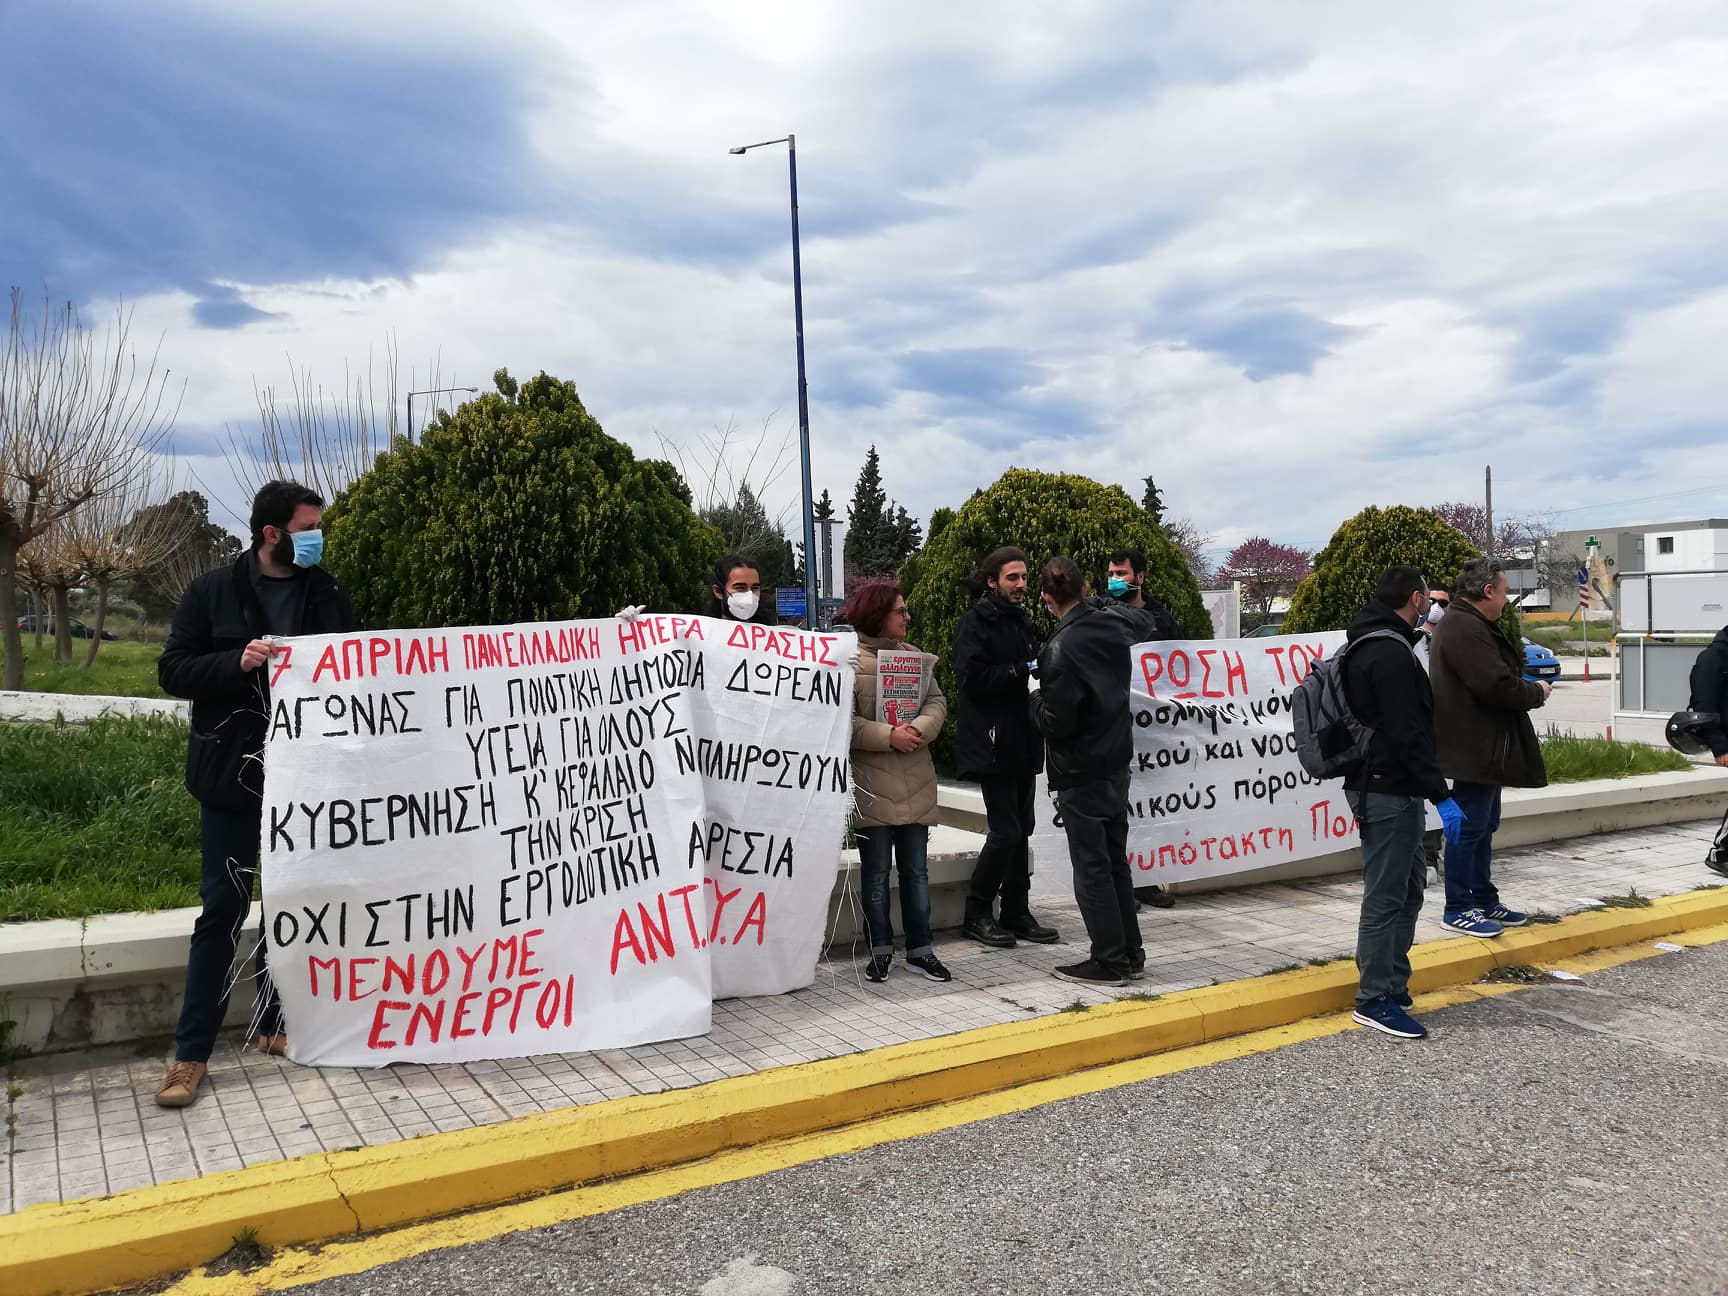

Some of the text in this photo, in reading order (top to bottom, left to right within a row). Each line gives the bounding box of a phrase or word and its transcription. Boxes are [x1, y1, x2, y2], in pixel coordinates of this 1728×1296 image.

[270, 617, 839, 688] 7 ΑΠΡΙΛΗ ΠΑΝΕΛΛΑΔΙΚΗ ΗΜΕΡΑ ΔΡΑΣΗΣ
[270, 650, 842, 742] ΑΓΩΝΑΣ ΓΙΑ ΠΟΙΟΤΙΚΗ ΔΗΜΟΣΙΑ ΔΩΡΕΑΝ
[1250, 688, 1293, 724] μόν
[466, 692, 688, 780] ΥΓΕΙΑ ΓΙΑ ΟΛΟΥΣ
[1137, 740, 1191, 772] κού
[1205, 739, 1244, 762] και
[270, 782, 497, 852] ΚΥΒΕΡΝΗΣΗ
[556, 749, 655, 812] ΚΕΦΑΛΑΙΟ
[500, 793, 648, 870] ΤΗΝ ΚΡΙΣΗ
[273, 902, 347, 947] ΟΧΙ
[365, 884, 474, 947] ΣΤΗΝ
[500, 832, 660, 927] ΕΡΓΟΔΟΤΙΚΗ
[308, 928, 545, 1001] ΜΕΝΟΥΜΕ
[367, 974, 574, 1049] ΕΝΕΡΓΟΙ
